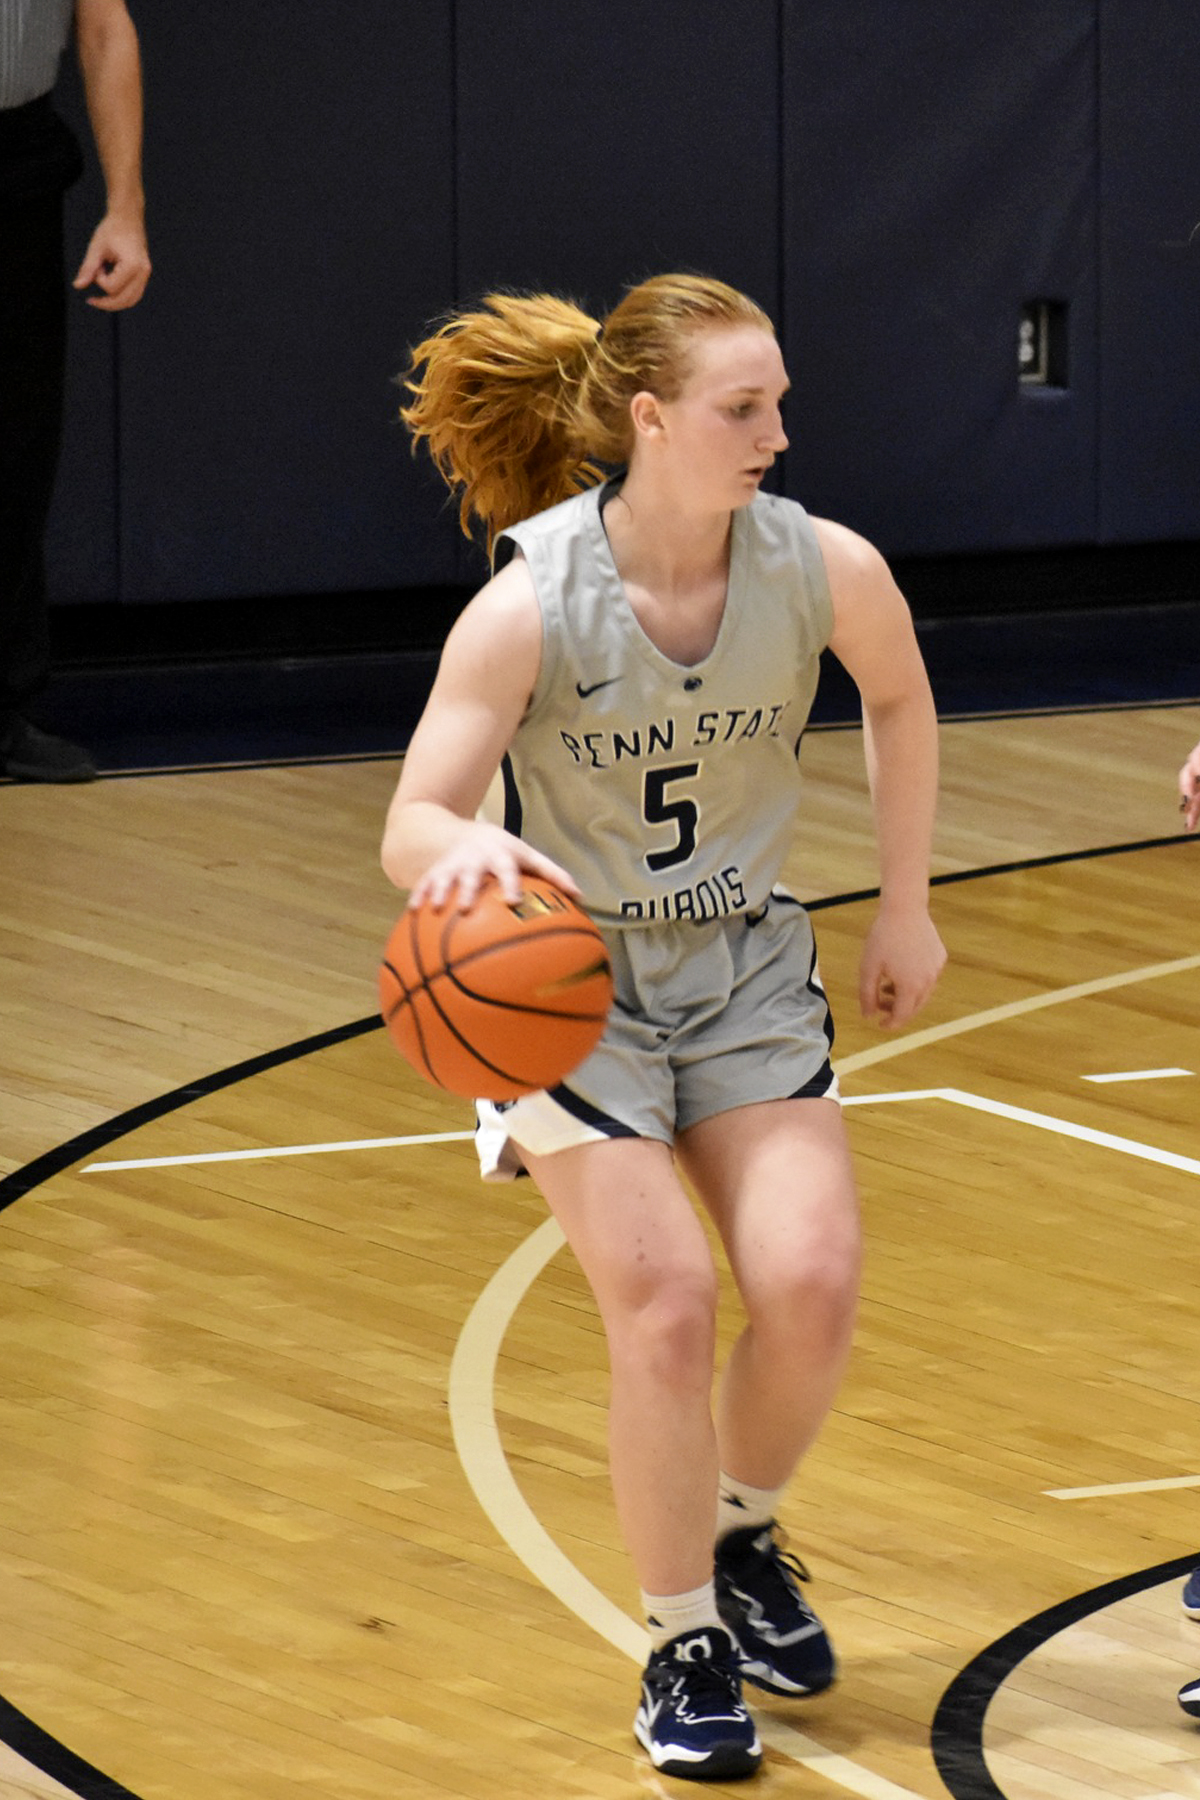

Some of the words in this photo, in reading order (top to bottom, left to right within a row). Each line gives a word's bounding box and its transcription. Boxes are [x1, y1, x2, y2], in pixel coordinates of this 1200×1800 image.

[559, 718, 675, 769] PENN
[692, 701, 790, 747] STAT
[642, 760, 703, 873] 5
